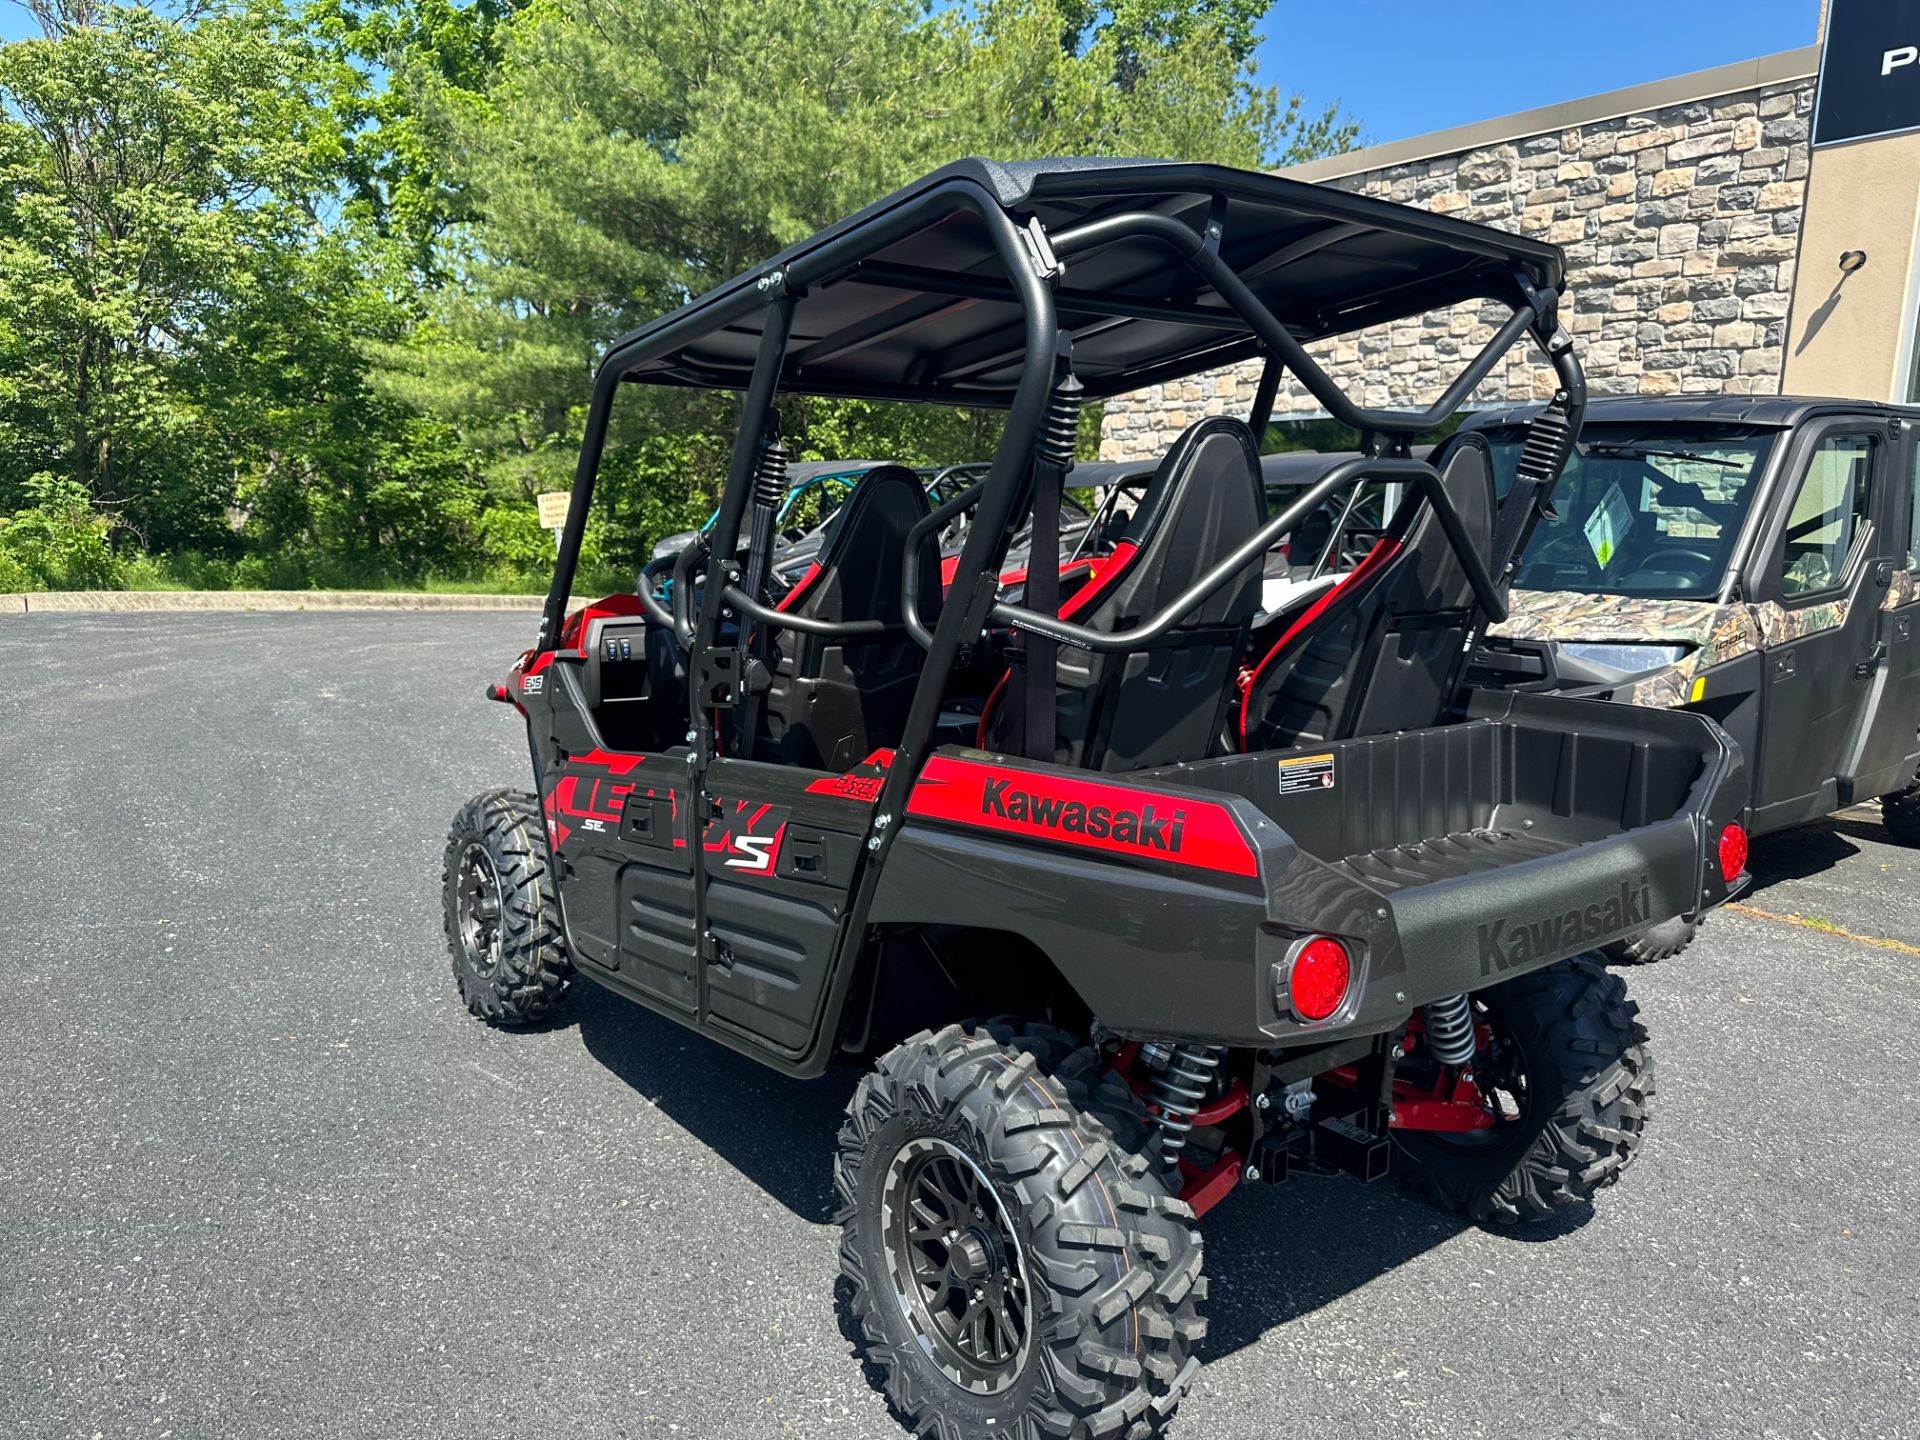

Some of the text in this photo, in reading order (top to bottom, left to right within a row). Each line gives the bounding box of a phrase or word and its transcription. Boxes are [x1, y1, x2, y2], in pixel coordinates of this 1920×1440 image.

[1881, 45, 1920, 76] P
[1711, 613, 1748, 643] XP
[1714, 630, 1748, 652] 1000
[834, 774, 882, 799] 4x4
[581, 818, 607, 833] SE
[981, 776, 1188, 853] Kawasaki
[1477, 874, 1651, 977] Kawasaki
